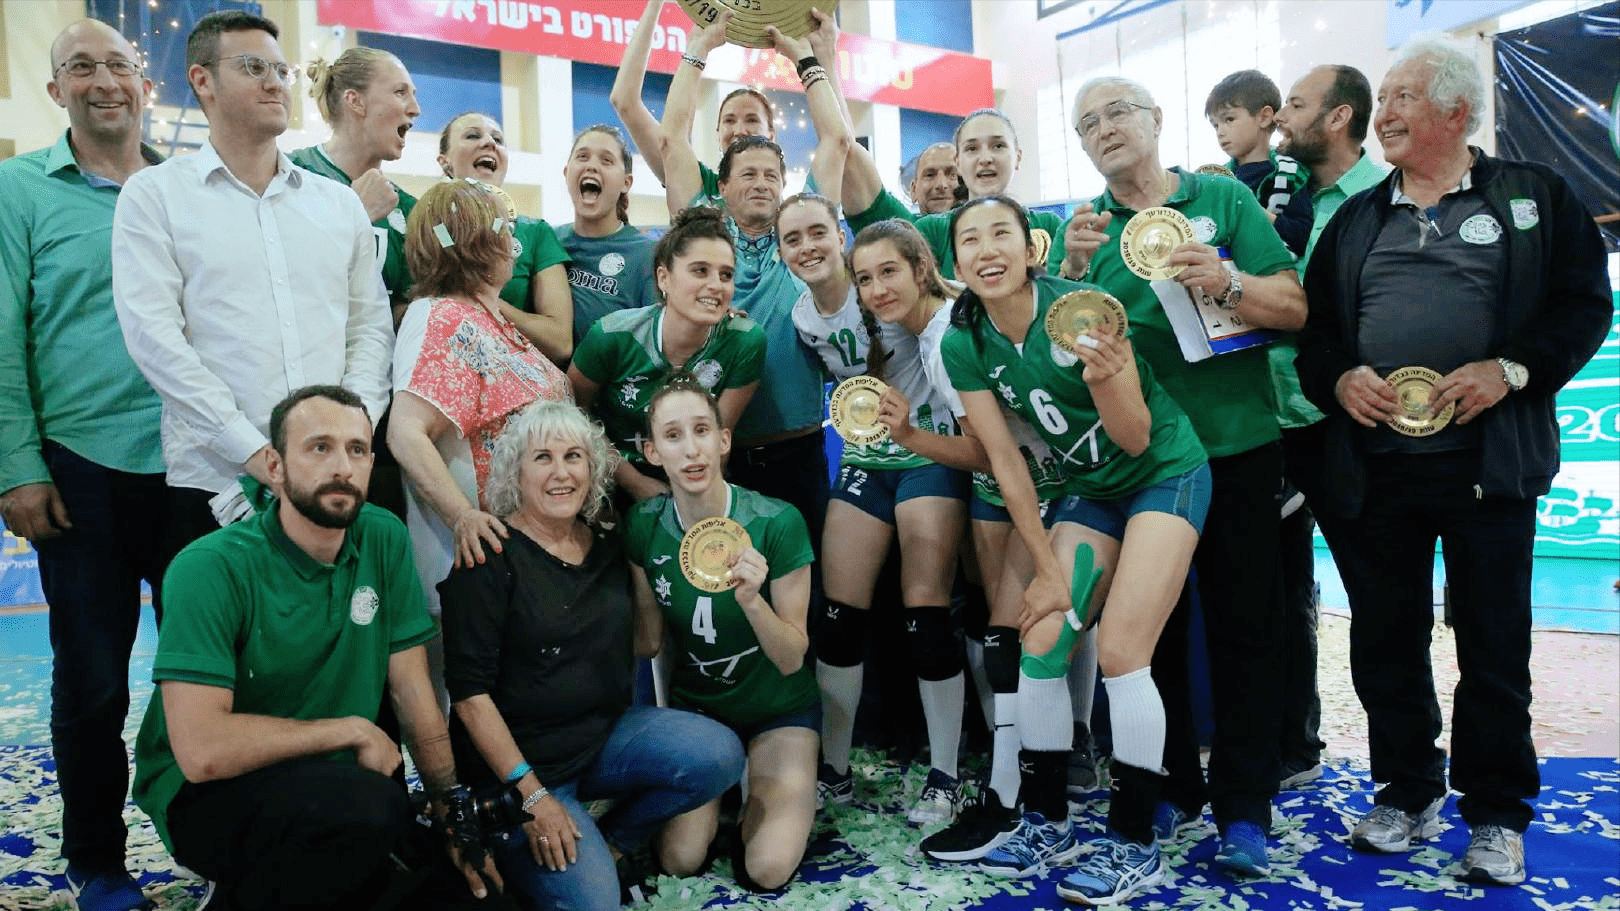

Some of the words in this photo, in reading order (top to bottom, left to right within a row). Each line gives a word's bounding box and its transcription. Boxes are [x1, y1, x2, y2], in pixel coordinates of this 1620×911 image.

[567, 267, 619, 297] oma
[827, 327, 866, 368] 12
[1029, 388, 1069, 435] 6
[692, 596, 718, 645] 4
